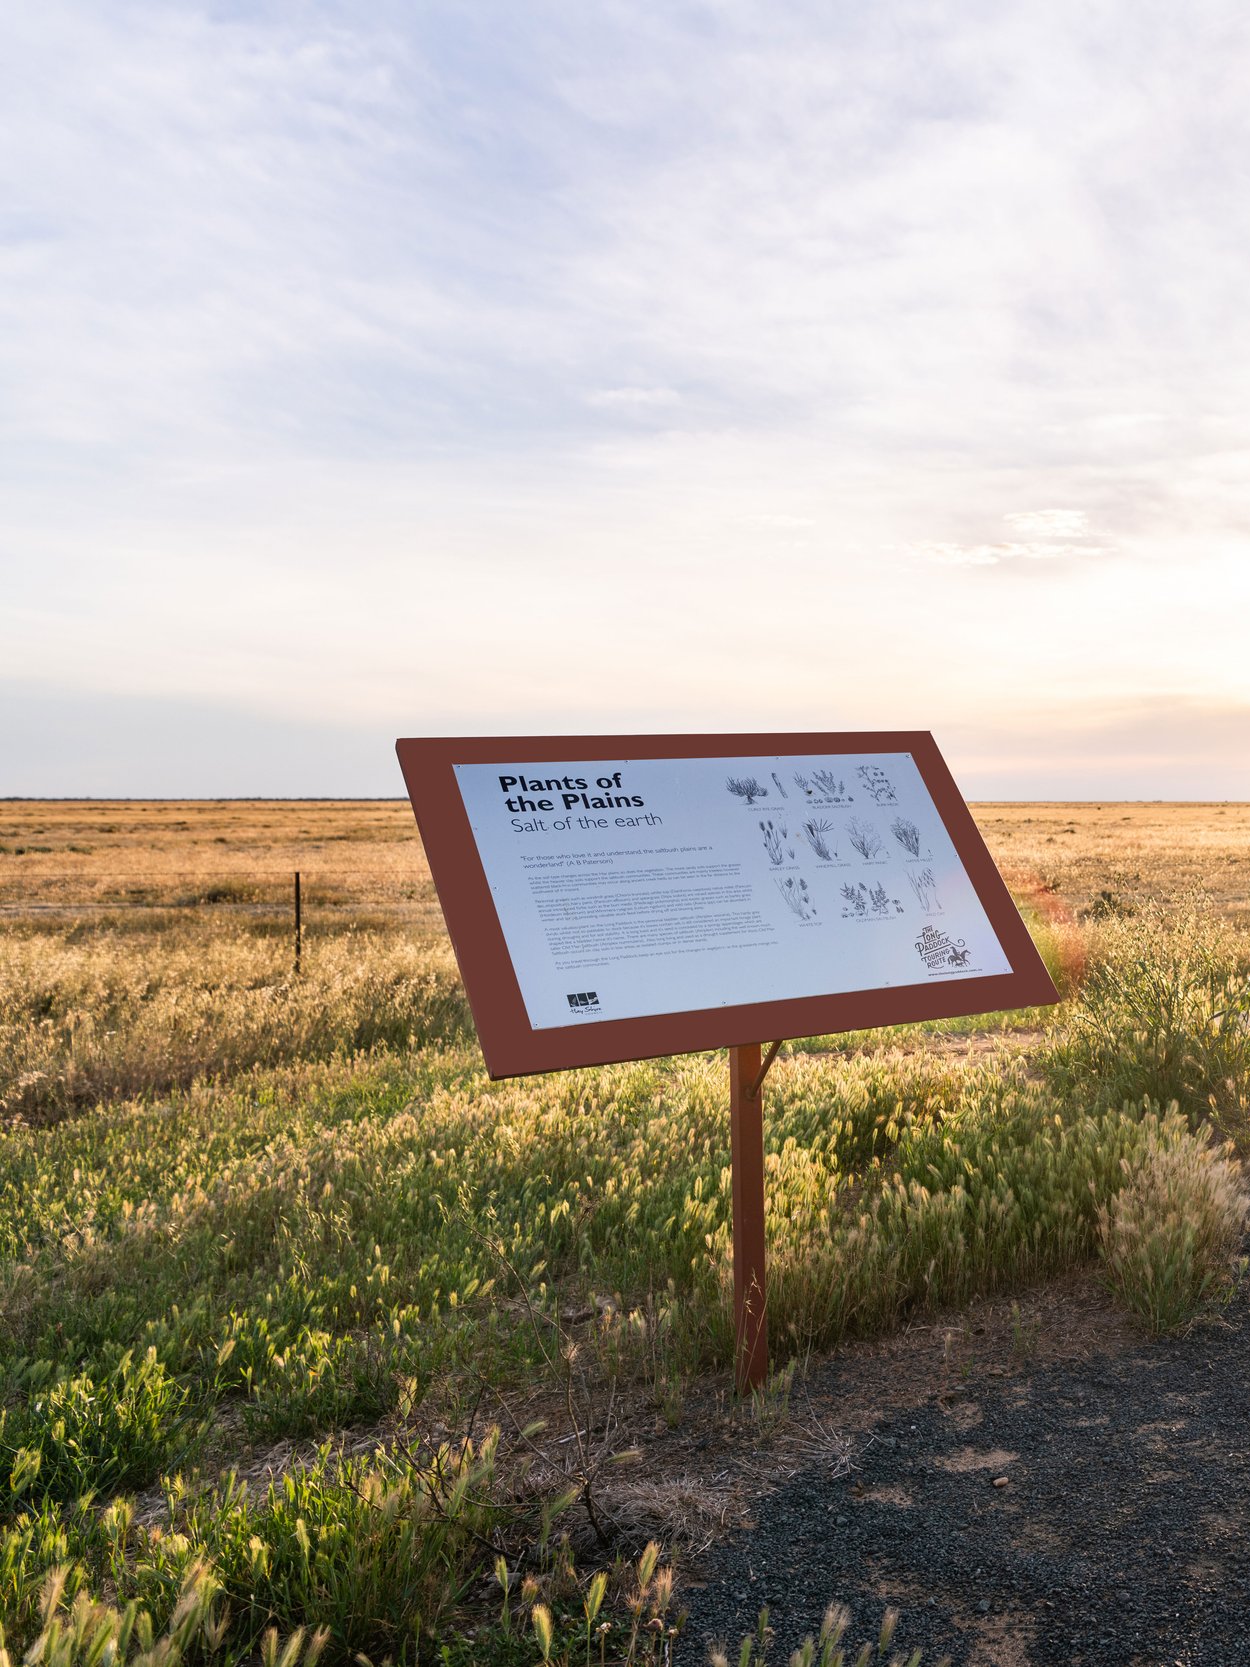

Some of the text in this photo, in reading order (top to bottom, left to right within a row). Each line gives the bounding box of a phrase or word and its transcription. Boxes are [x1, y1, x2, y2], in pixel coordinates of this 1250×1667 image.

[498, 772, 622, 793] Plants of
[504, 792, 645, 813] the Plains
[511, 813, 663, 833] Salt of the earth
[583, 858, 614, 866] Paterson)
[922, 925, 933, 933] THE
[917, 930, 945, 944] LONG
[915, 936, 950, 956] PADDOCK
[921, 948, 950, 962] TOURING
[927, 957, 946, 969] ROUTE
